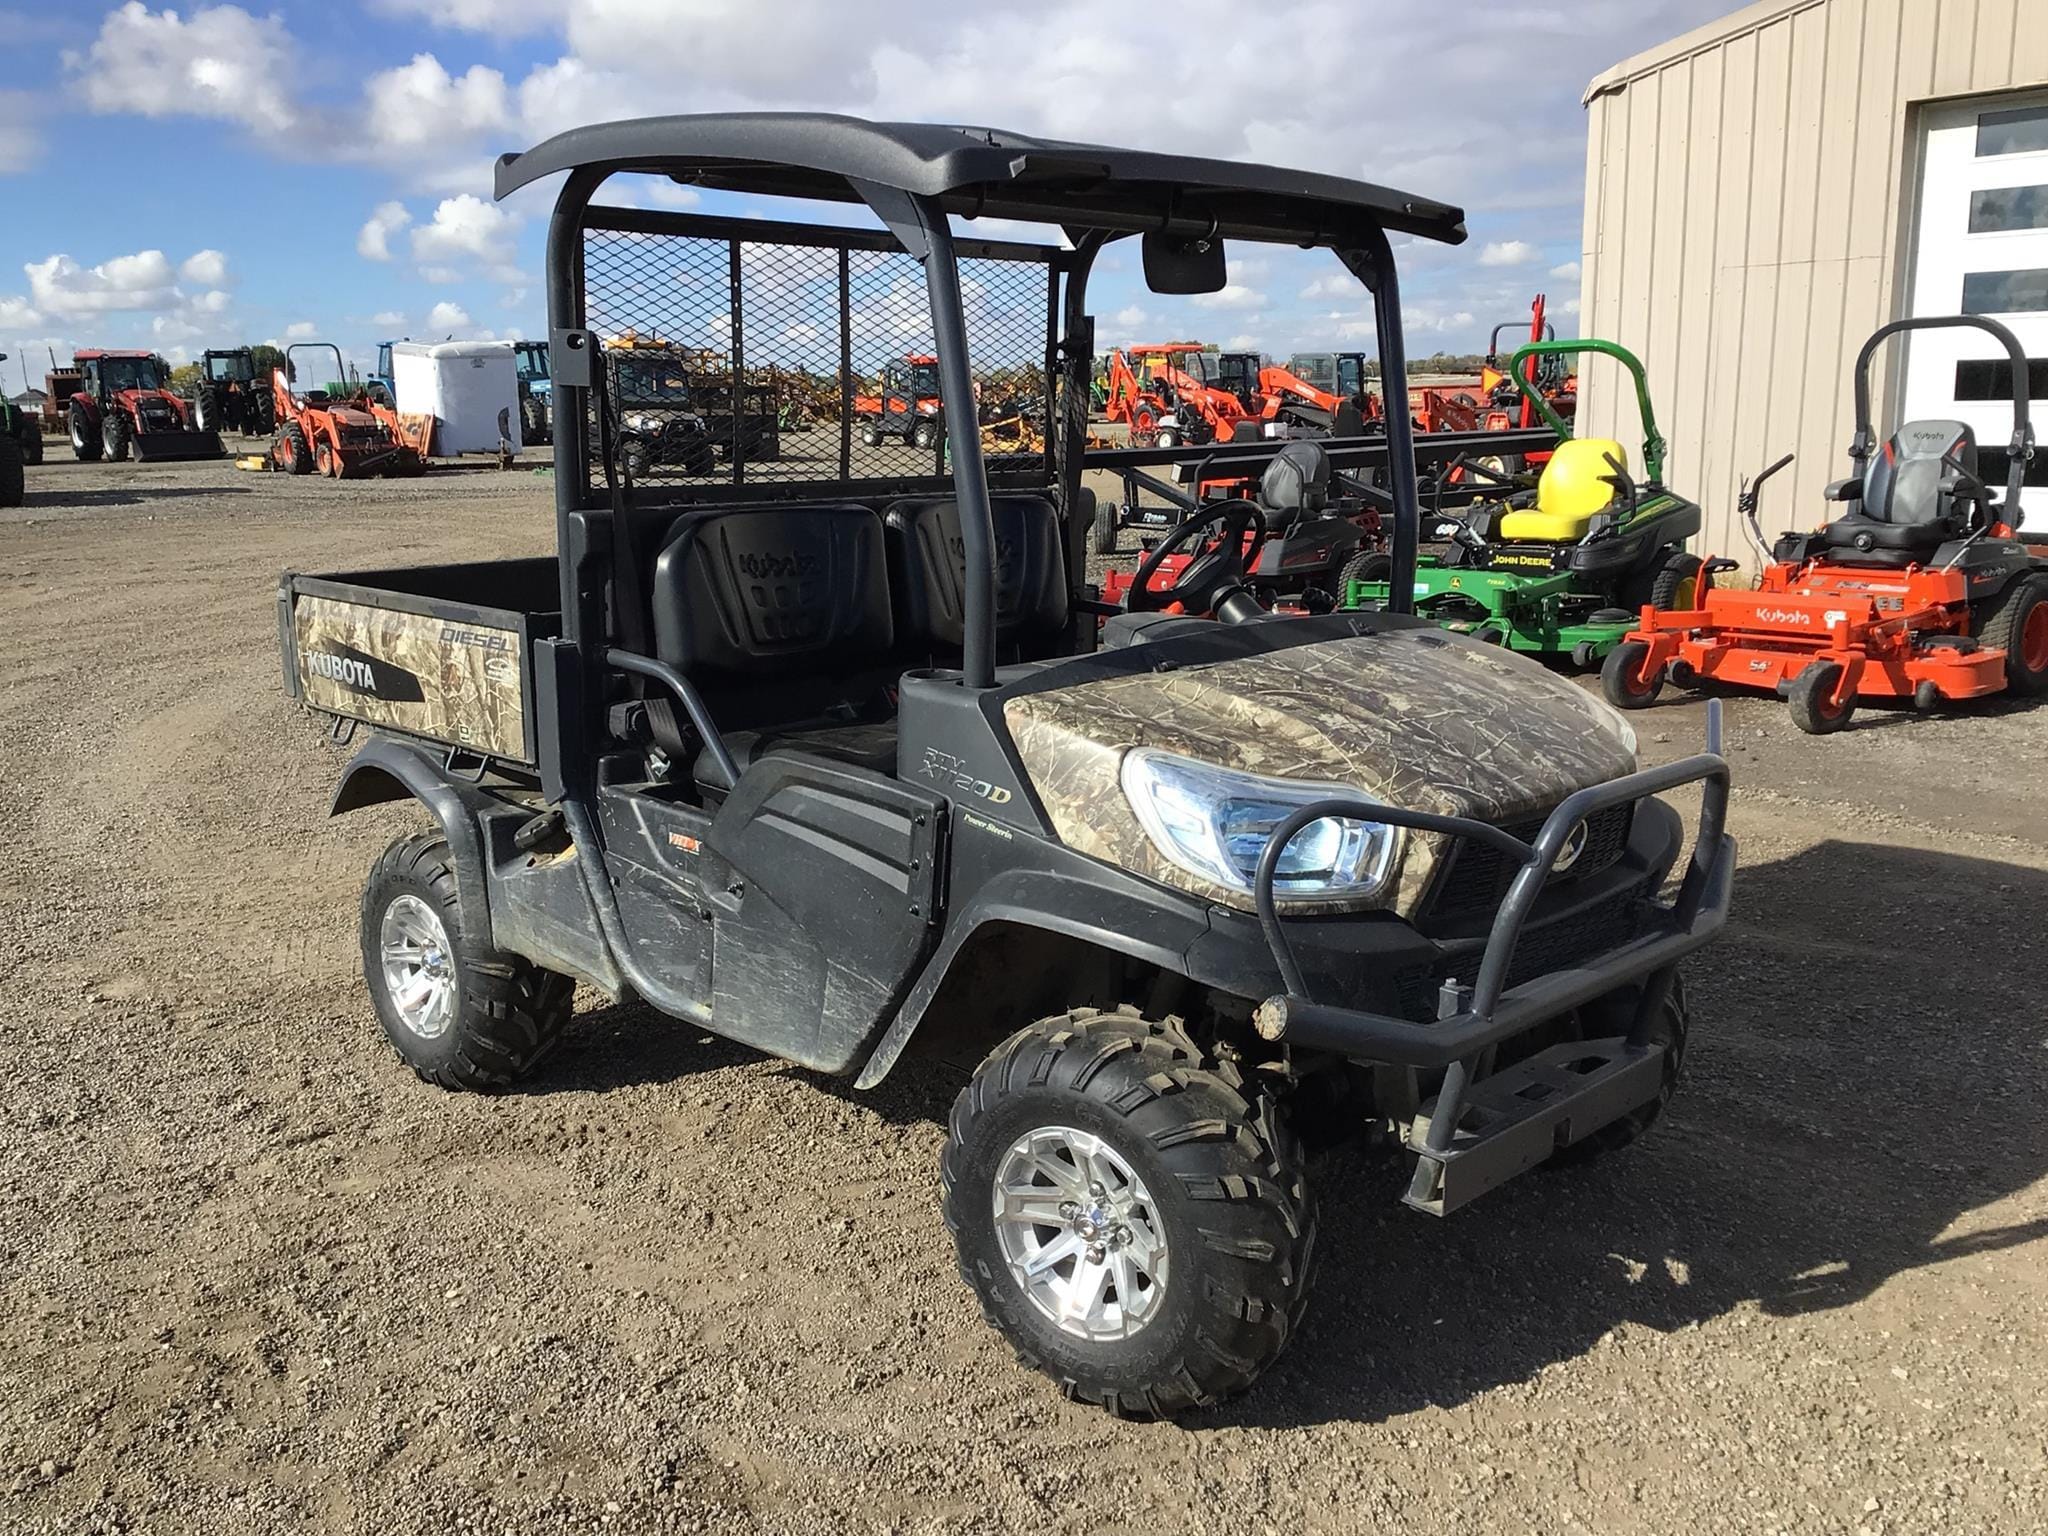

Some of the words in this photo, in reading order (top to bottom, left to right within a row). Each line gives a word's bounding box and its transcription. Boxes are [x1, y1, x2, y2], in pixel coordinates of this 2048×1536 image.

[1912, 431, 1945, 440] Kubota
[1493, 555, 1518, 564] JOHN
[1520, 556, 1552, 566] DEERE
[1756, 608, 1811, 624] Kubota
[439, 628, 514, 652] DIESEL
[308, 650, 377, 691] KUBOTA
[925, 746, 966, 768] RTV
[963, 813, 987, 828] Power
[985, 822, 1013, 840] Steerin
